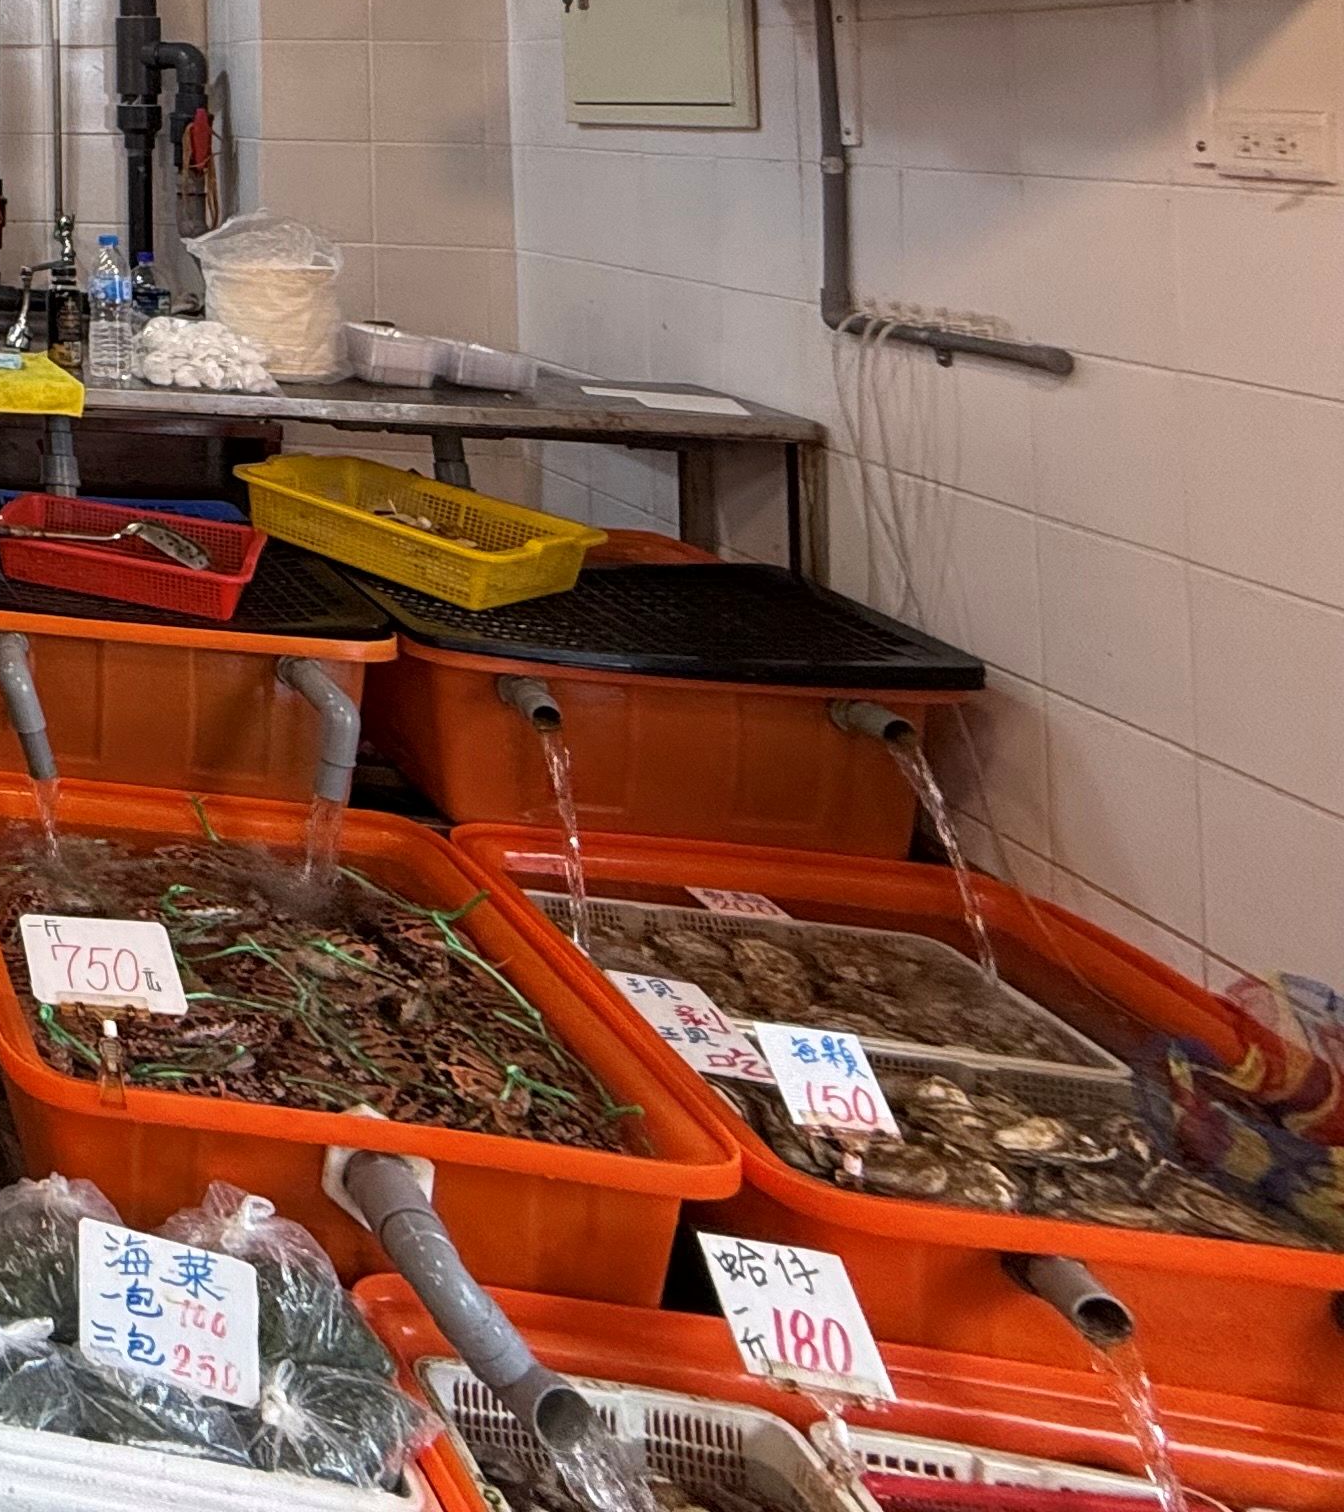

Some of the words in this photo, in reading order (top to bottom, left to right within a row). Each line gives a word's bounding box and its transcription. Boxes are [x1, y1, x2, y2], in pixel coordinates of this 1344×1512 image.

[806, 1080, 878, 1125] 150
[103, 1231, 225, 1301] 海菜
[712, 1241, 819, 1296] 蛤仔
[100, 1278, 163, 1318] 一包
[772, 1307, 853, 1374] 180
